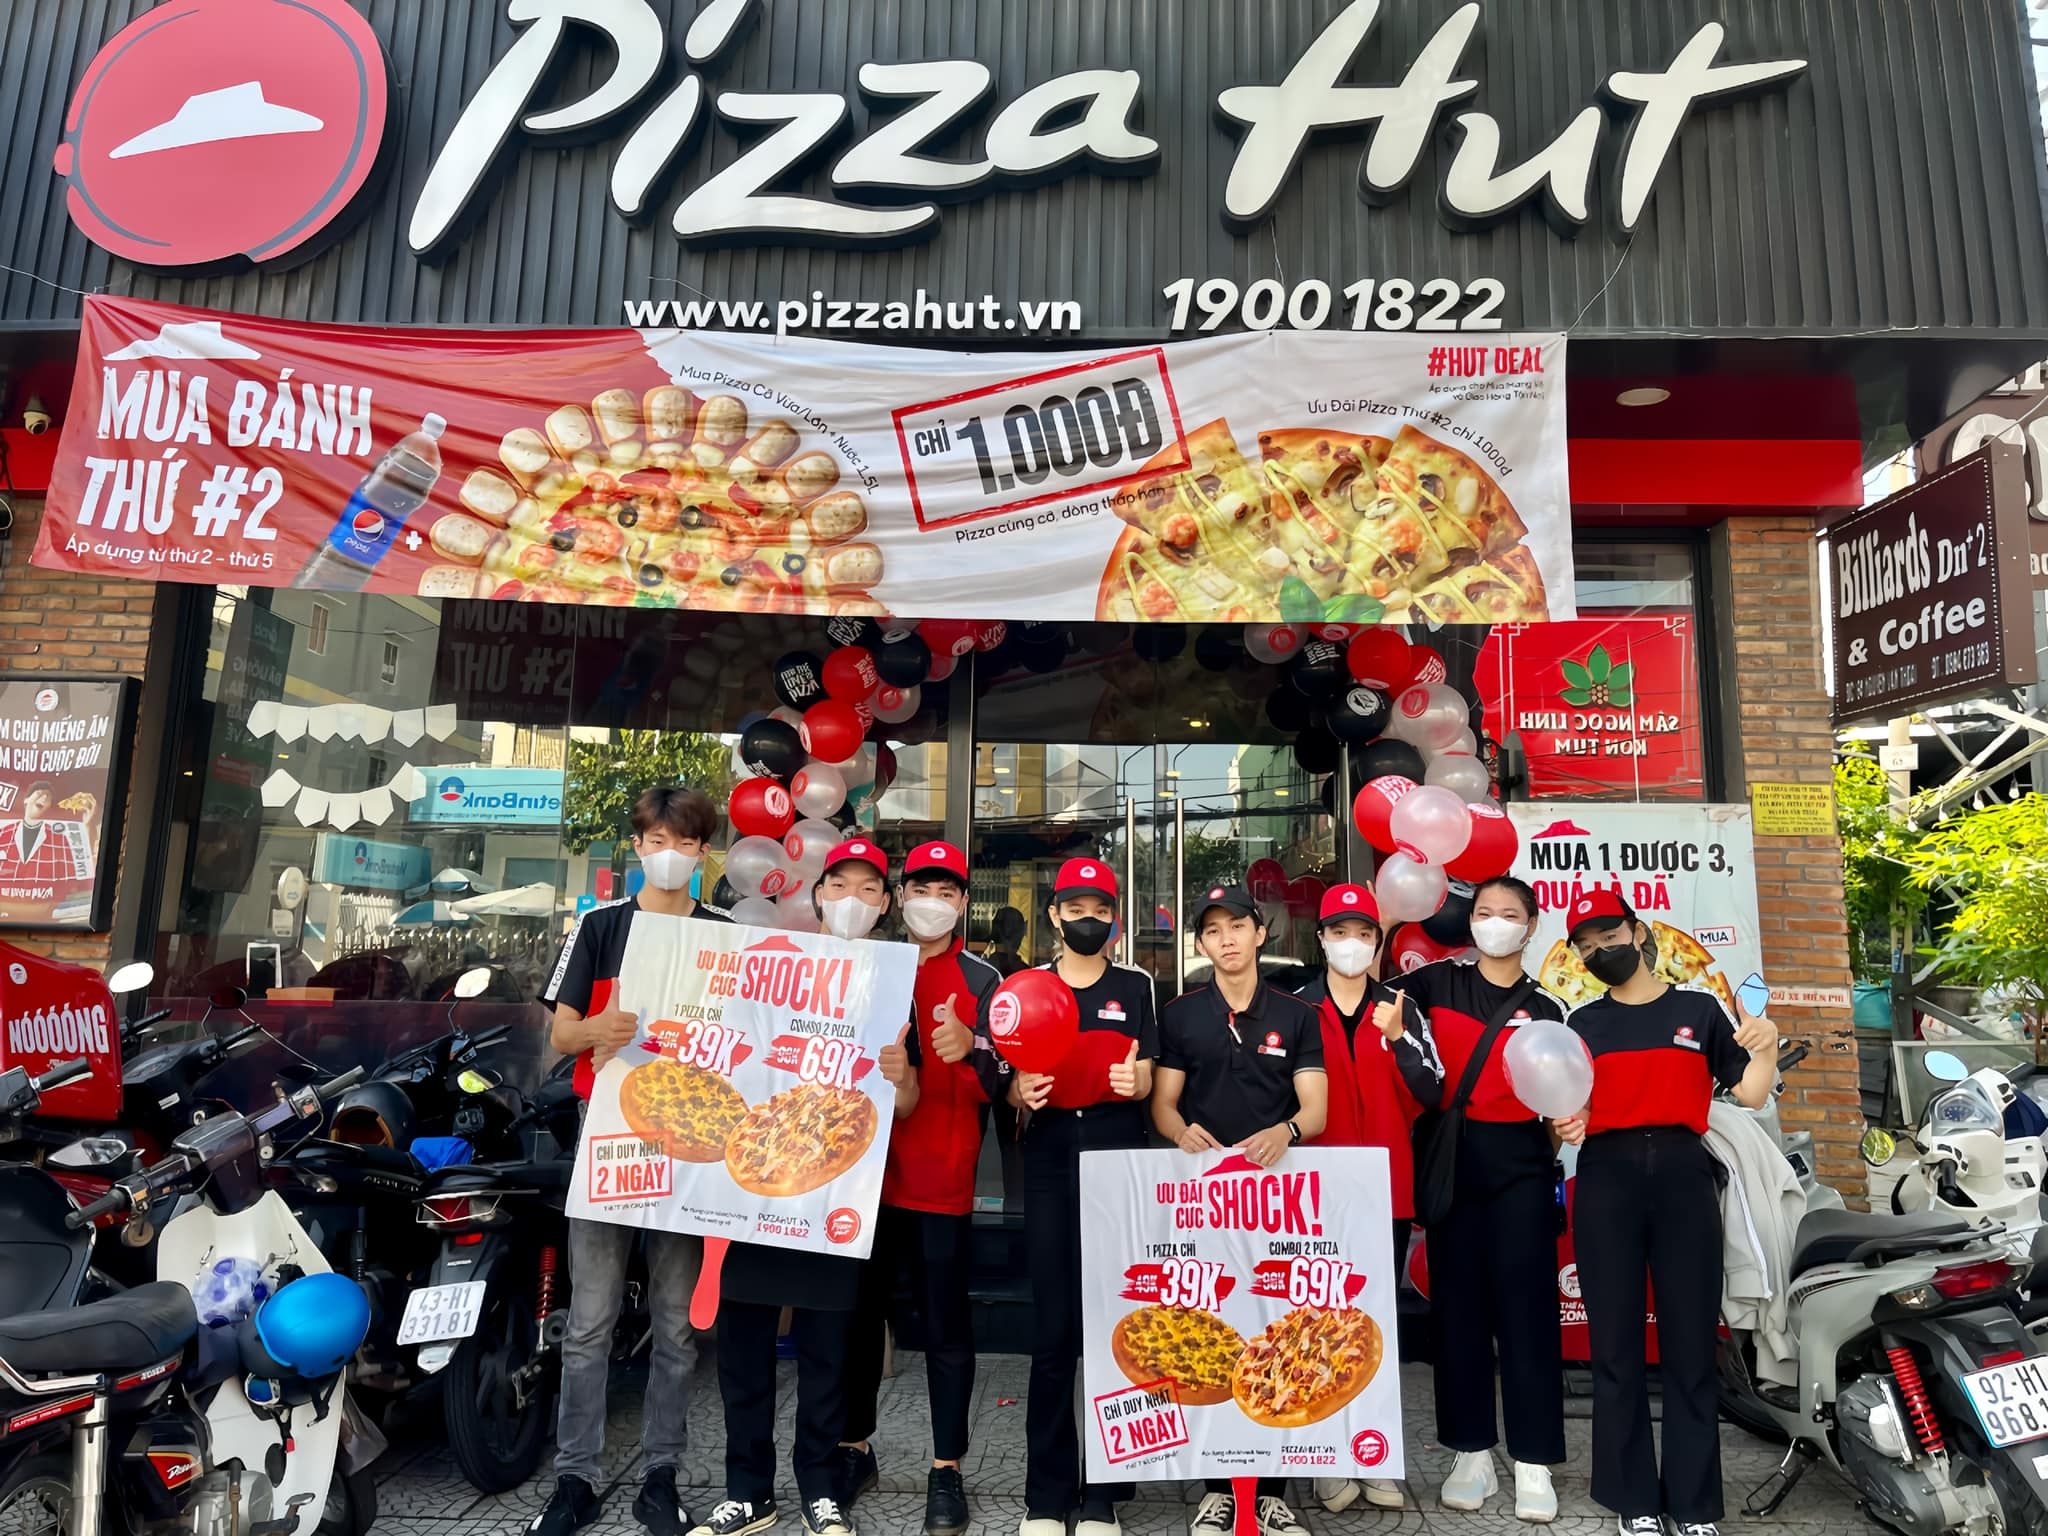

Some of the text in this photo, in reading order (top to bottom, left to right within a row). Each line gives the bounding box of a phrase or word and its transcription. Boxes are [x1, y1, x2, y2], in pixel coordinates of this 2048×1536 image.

[408, 0, 1808, 251] Pizza Hut
[624, 288, 1081, 336] www.pizzahut.vn
[1162, 278, 1506, 331] 1900 1822
[680, 365, 711, 381] Mua
[713, 371, 751, 392] Pizza
[1427, 346, 1546, 378] #HUT DEAL
[96, 365, 373, 456] MUA BÁNH
[1308, 398, 1330, 415] Ưu
[1331, 398, 1356, 413] Đãi
[1358, 399, 1398, 417] Pizza
[1401, 403, 1430, 423] Thứ
[1430, 411, 1453, 431] #2
[914, 377, 1163, 495] CHỈ 1.000Đ
[76, 448, 284, 541] THỨ #2
[955, 525, 996, 545] Pizza
[998, 514, 1036, 536] cùng
[1061, 499, 1100, 521] dòng
[1101, 489, 1137, 512] thấp
[65, 533, 91, 560] Áp
[94, 540, 144, 565] dụng
[148, 546, 167, 563] từ
[169, 546, 199, 566] thứ
[200, 549, 213, 565] 2
[229, 549, 260, 568] thứ
[260, 552, 274, 569] 5
[1837, 511, 1932, 619] Billiards
[1848, 597, 1987, 667] & Coffee
[13, 715, 40, 743] CHỦ
[41, 714, 87, 743] MIẾNG
[87, 713, 109, 739] ĂN
[14, 743, 39, 772] CHỦ
[40, 745, 75, 777] CUỘC
[1530, 839, 1735, 879] MUA 1 ĐƯỢC 3,
[1533, 871, 1583, 912] QUÁ
[1632, 874, 1672, 911] ĐÃ
[1699, 930, 1730, 944] MUA
[740, 955, 854, 1020] SHOCK!
[8, 1002, 110, 1053] NÓÓÓÓNG
[680, 1004, 705, 1019] PIZZA
[678, 1019, 747, 1077] 39K
[822, 1023, 830, 1036] 2
[830, 1024, 856, 1039] PIZZA
[800, 1034, 866, 1090] 69K
[596, 1141, 614, 1160] CHỈ
[617, 1143, 636, 1159] DUY
[597, 1158, 666, 1194] 2 NGÀY
[1156, 1179, 1204, 1205] ƯU ĐÃI
[1175, 1206, 1205, 1233] CỰC
[1208, 1171, 1323, 1237] SHOCK!
[756, 1222, 809, 1238] 1900 1822
[1146, 1239, 1197, 1258] 1 PIZZA CHỈ
[1269, 1241, 1339, 1256] COMBO 2 PIZZA
[418, 1286, 472, 1313] 43-H1
[1160, 1257, 1225, 1313] 39K
[1287, 1256, 1354, 1312] 69K
[404, 1310, 473, 1339] 331.81
[1978, 1363, 2048, 1404] 92-H1
[1103, 1397, 1123, 1420] CHỈ
[1123, 1396, 1143, 1415] DUY
[1110, 1409, 1178, 1454] 2 NGÀY
[1281, 1456, 1336, 1465] 1900 1822
